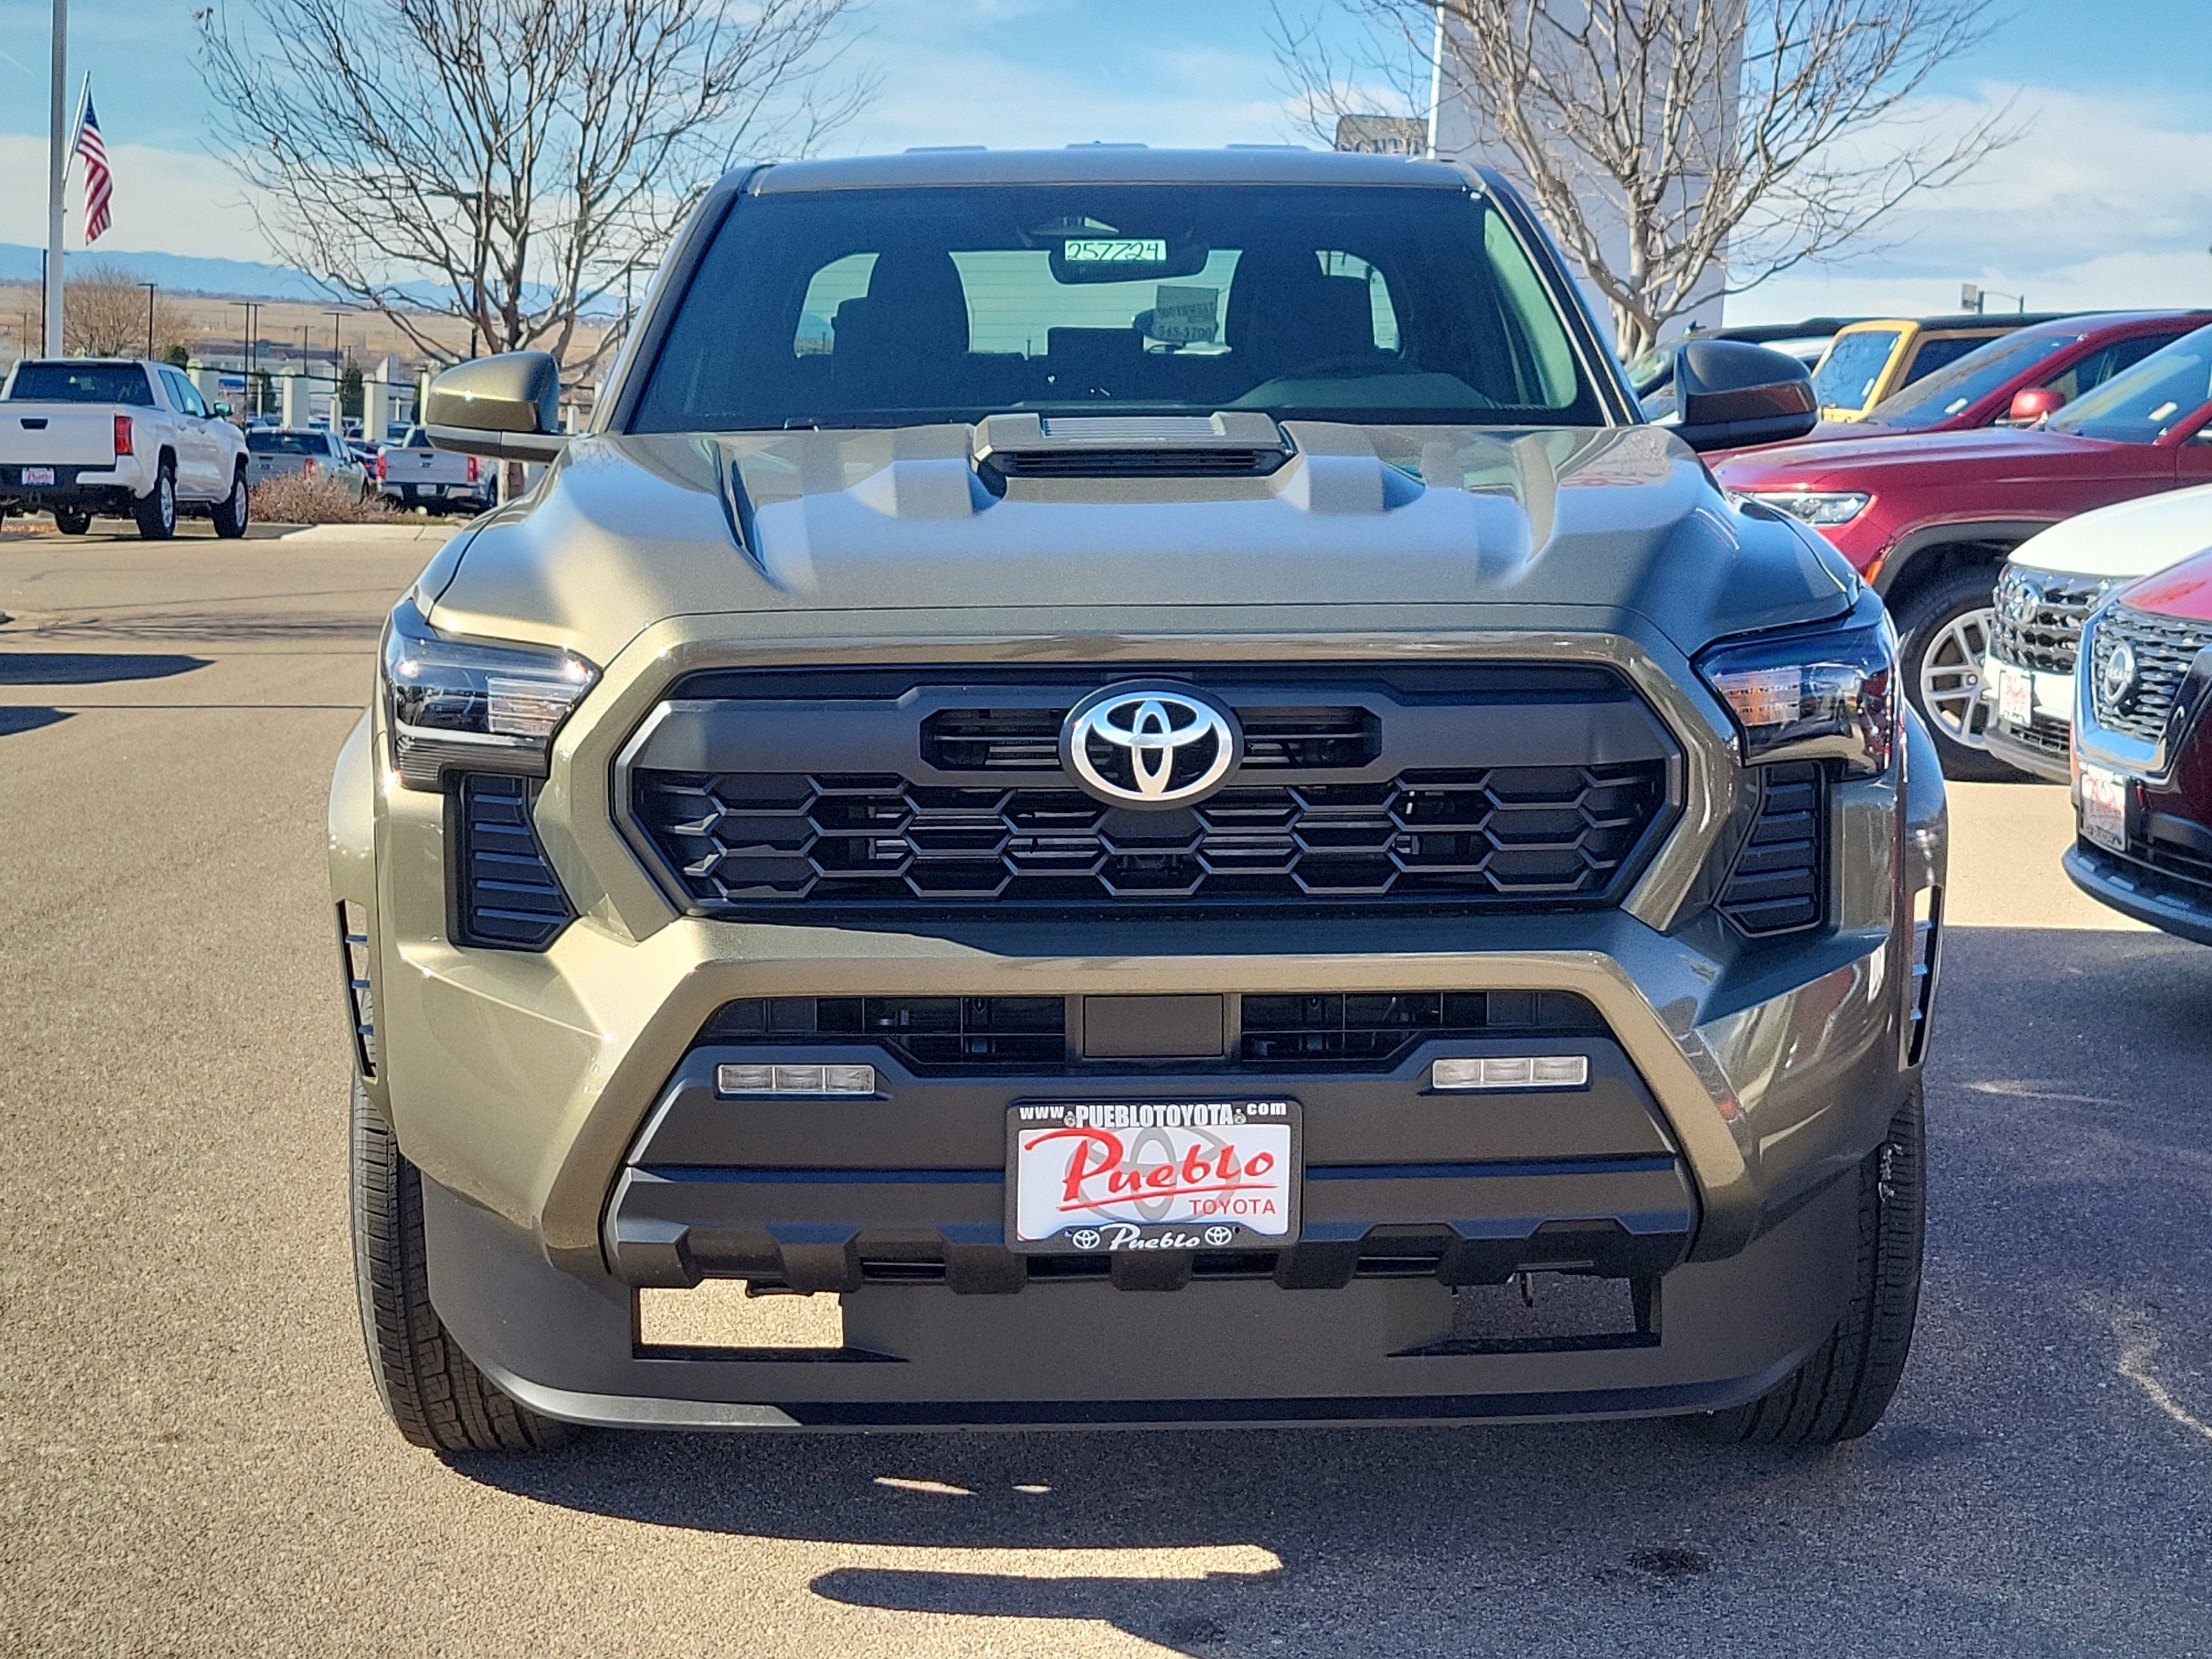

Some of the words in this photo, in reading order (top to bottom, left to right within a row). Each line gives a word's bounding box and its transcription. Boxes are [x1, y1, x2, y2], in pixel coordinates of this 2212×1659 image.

[1067, 242, 1159, 262] 257724
[1025, 1128, 1275, 1201] Pueblo
[1189, 1198, 1276, 1215] TOYOTA
[1099, 1223, 1201, 1251] Pueblo
